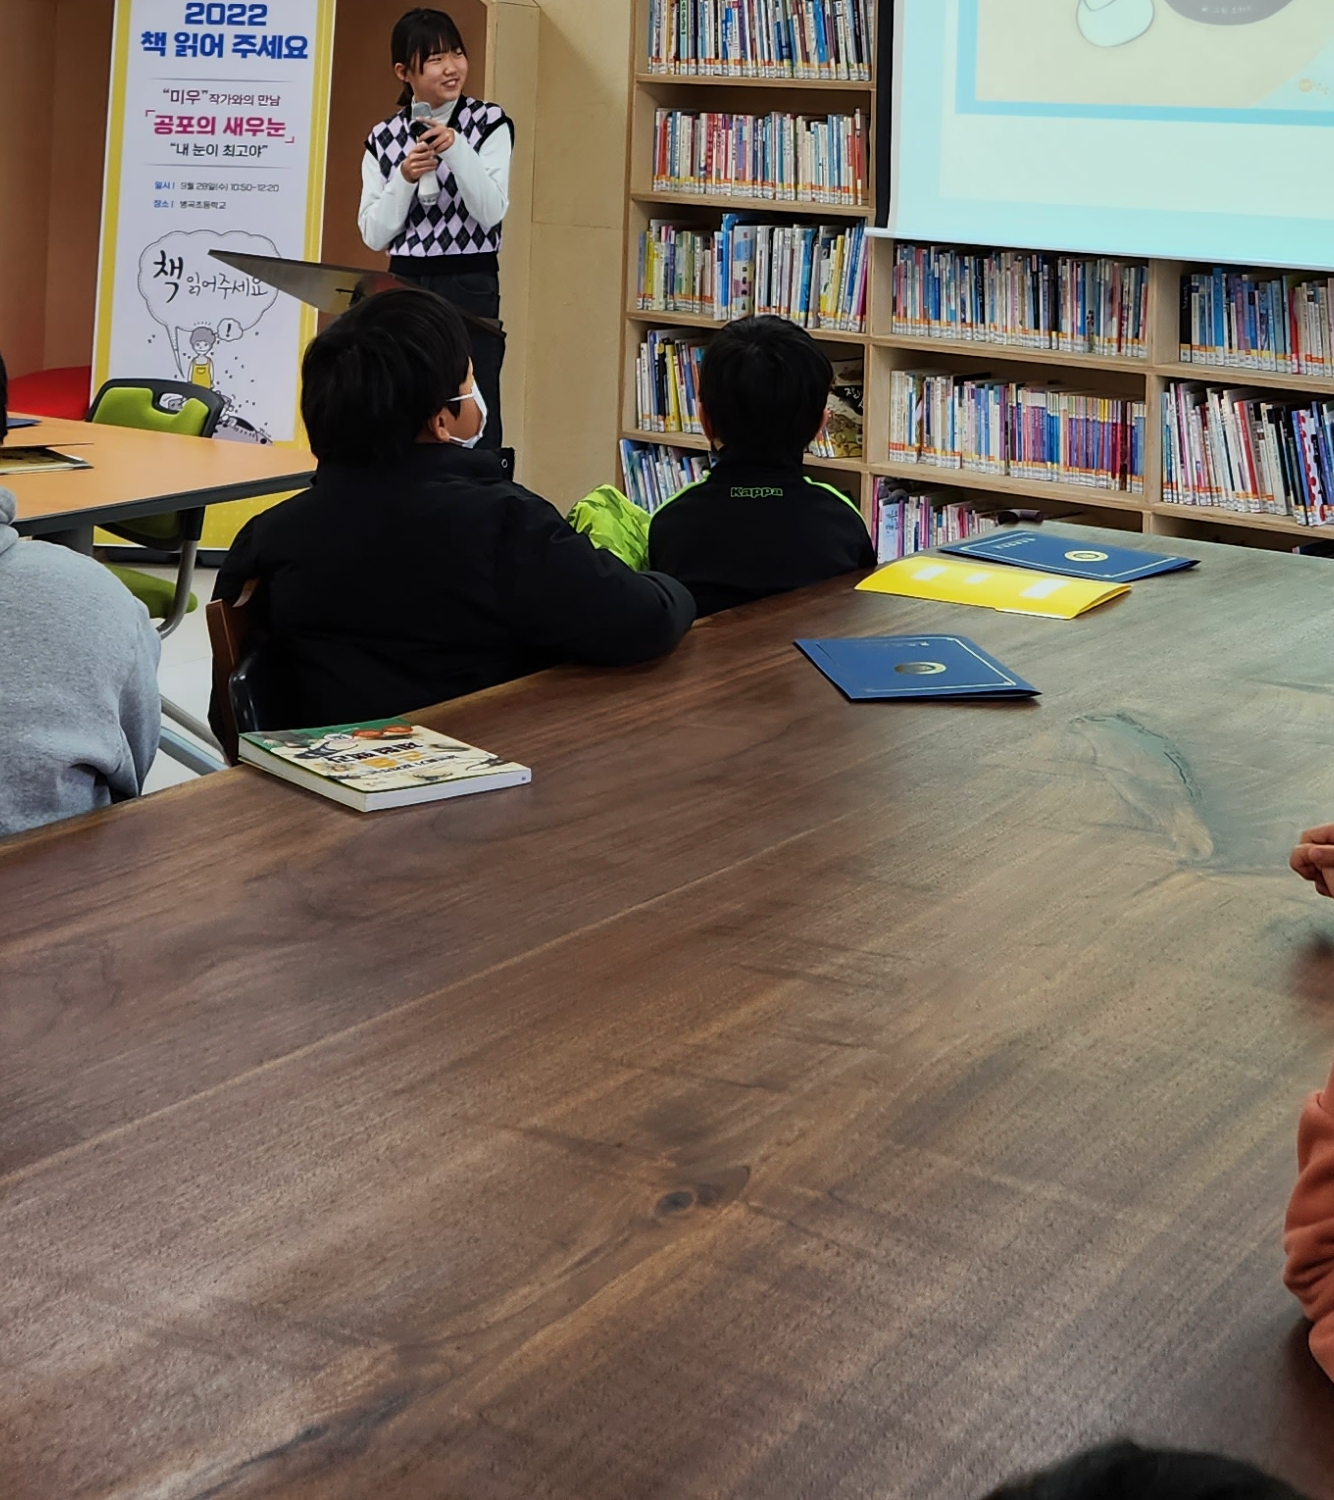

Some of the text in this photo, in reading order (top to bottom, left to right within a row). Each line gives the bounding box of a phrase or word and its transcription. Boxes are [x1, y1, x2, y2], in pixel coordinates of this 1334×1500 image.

[184, 2, 268, 27] 2022
[141, 31, 309, 60] 책 읽어 주세요
[257, 95, 281, 107] 만남
[192, 144, 218, 157] 눈이
[153, 250, 183, 303] 책
[730, 487, 783, 498] Kappa
